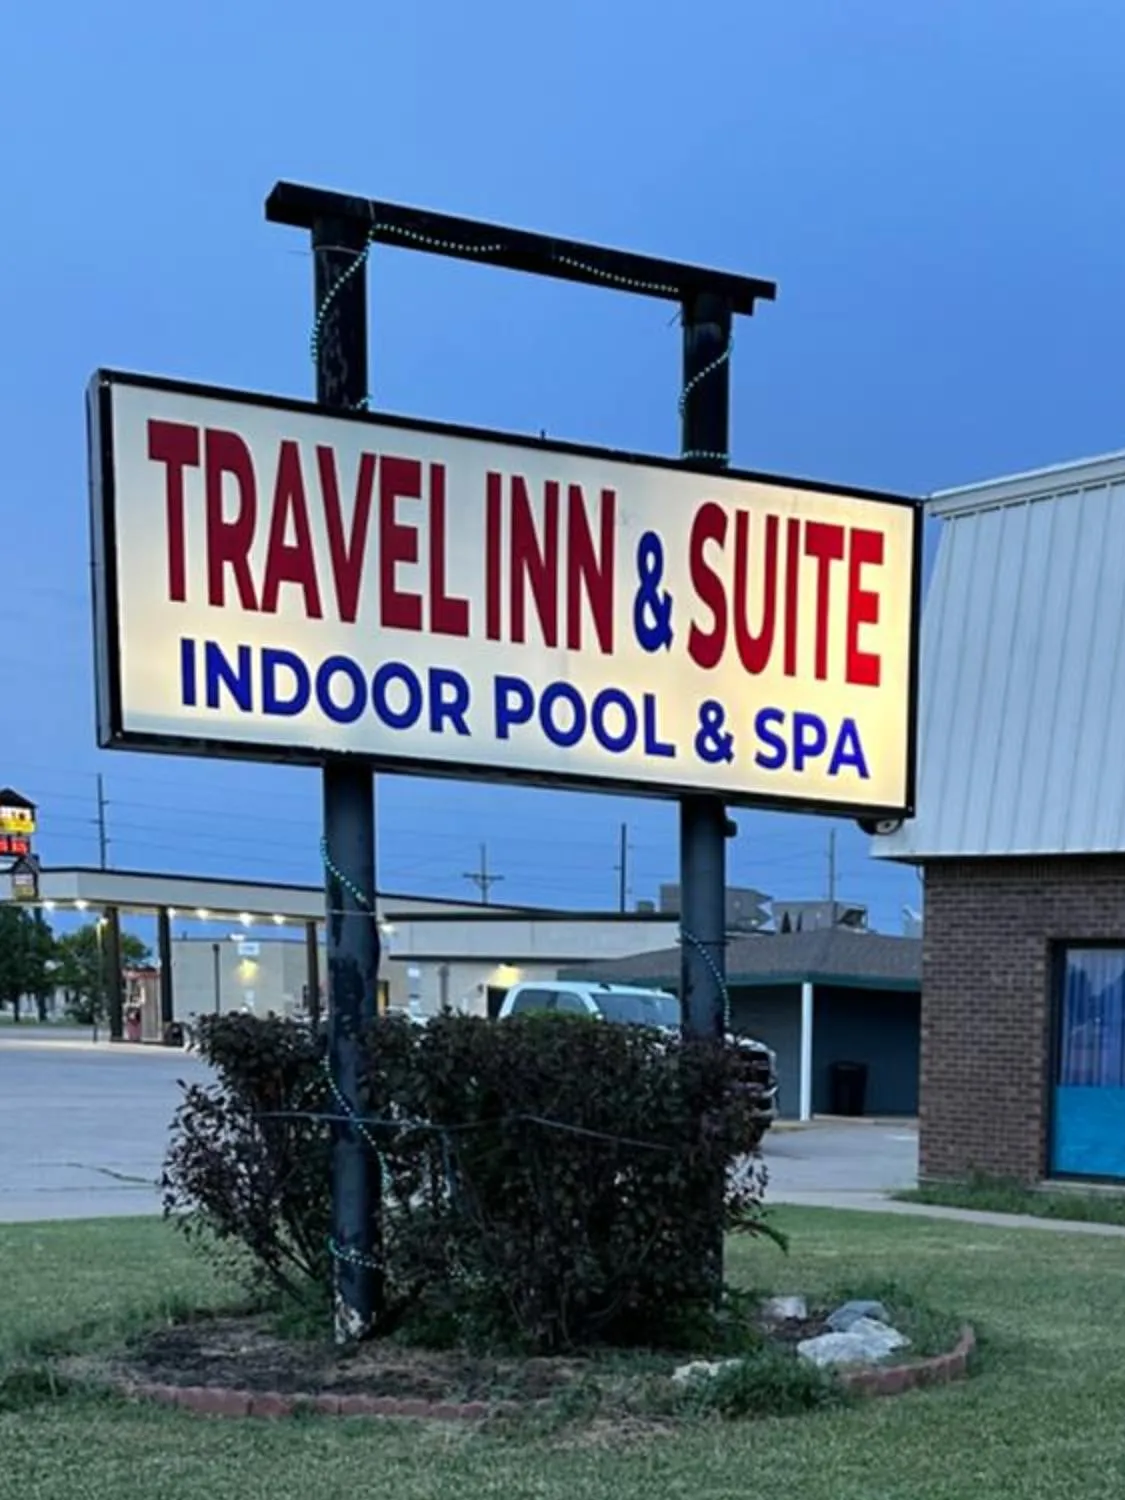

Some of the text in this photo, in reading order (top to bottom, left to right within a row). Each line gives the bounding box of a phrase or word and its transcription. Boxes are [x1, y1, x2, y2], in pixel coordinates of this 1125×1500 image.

[148, 419, 885, 687] TRAVEL INN & SUITE
[180, 638, 870, 778] INDOOR POOL & SPA
